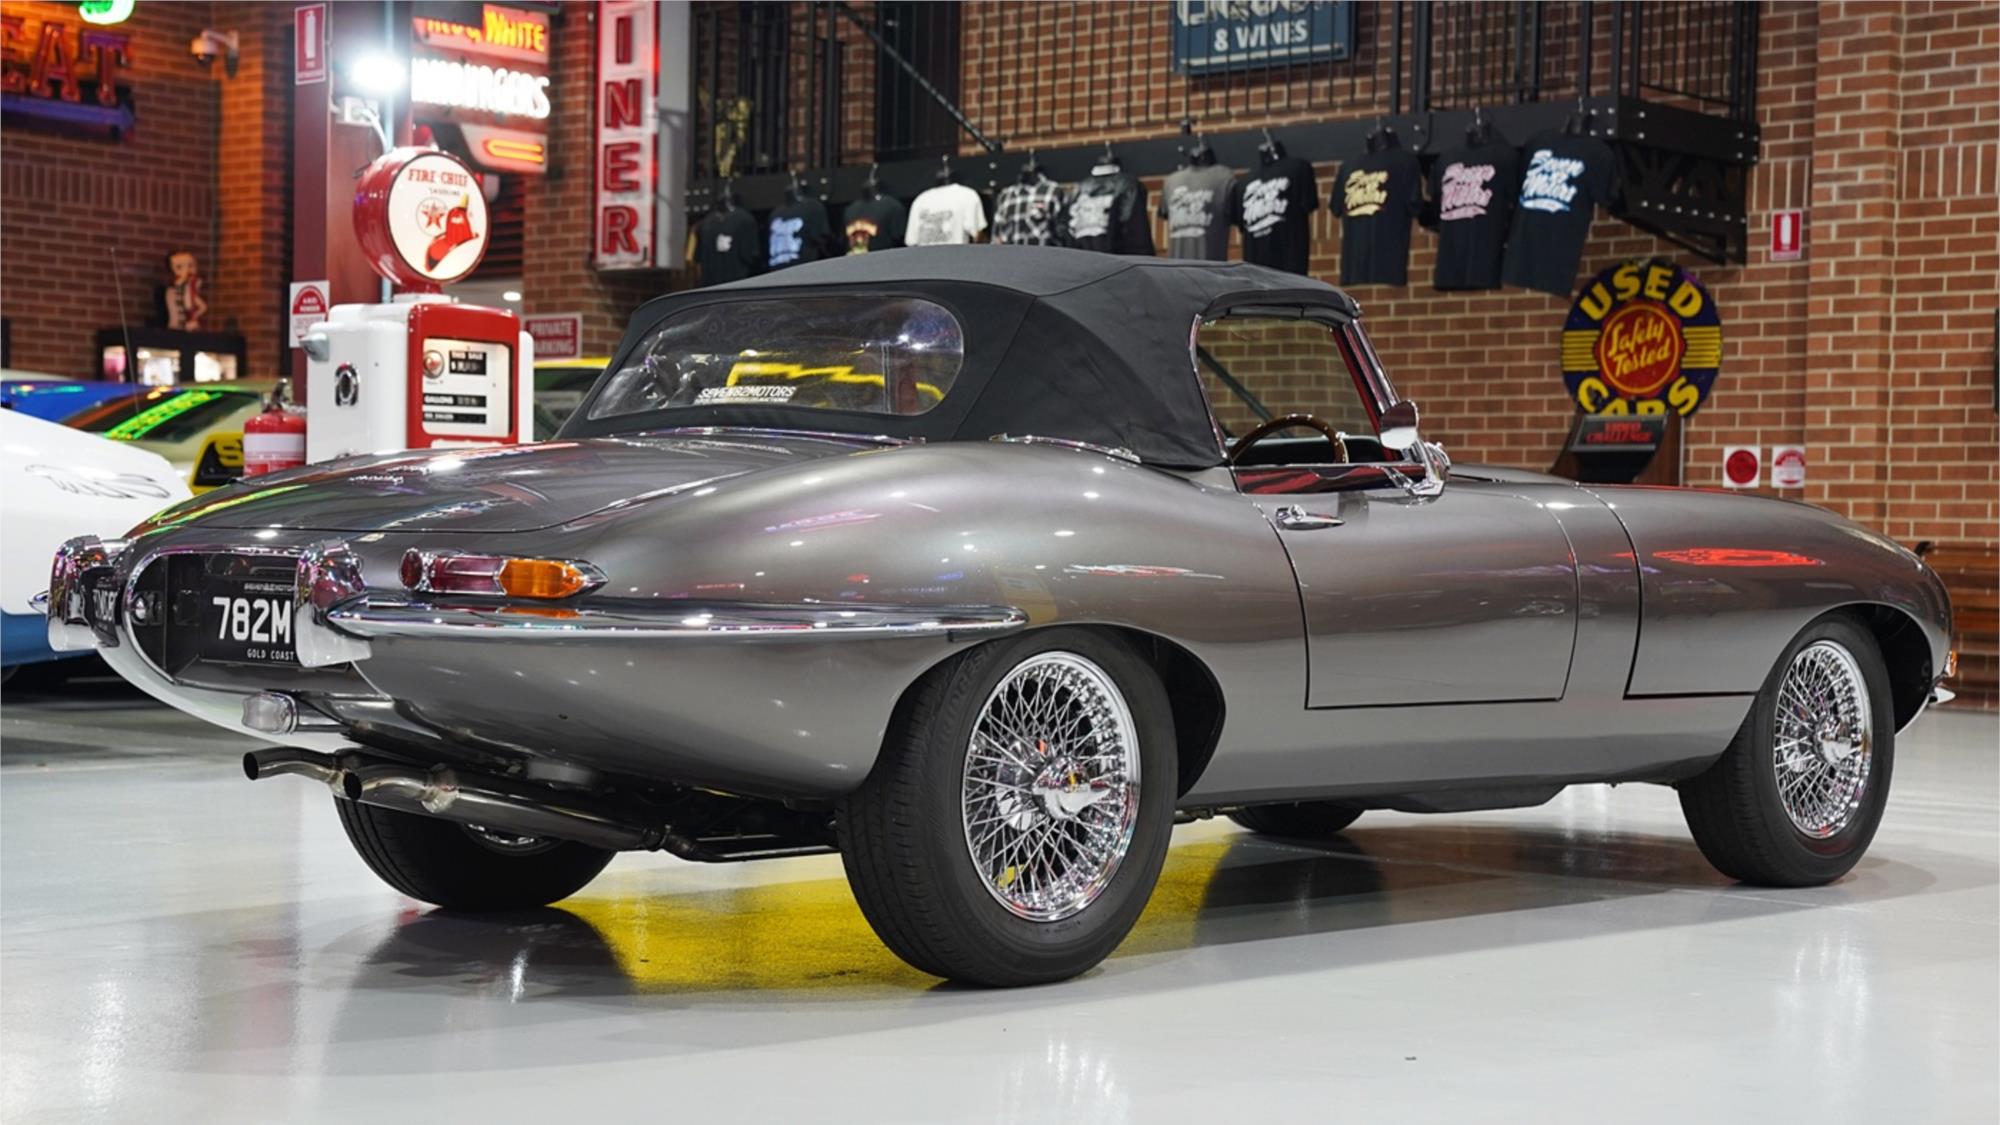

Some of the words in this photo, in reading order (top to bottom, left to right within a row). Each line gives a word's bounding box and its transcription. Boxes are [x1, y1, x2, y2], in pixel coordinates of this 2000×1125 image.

[484, 10, 546, 52] WHITE
[408, 168, 436, 183] FIRE
[440, 171, 469, 188] CHIEF
[1579, 265, 1704, 321] USED
[529, 319, 572, 337] PRIVATE
[532, 338, 576, 355] ARKING
[1607, 315, 1666, 357] Safety
[1613, 337, 1671, 378] Tested
[212, 596, 292, 644] 782M
[246, 648, 267, 660] GOLD
[270, 650, 295, 661] COAST
